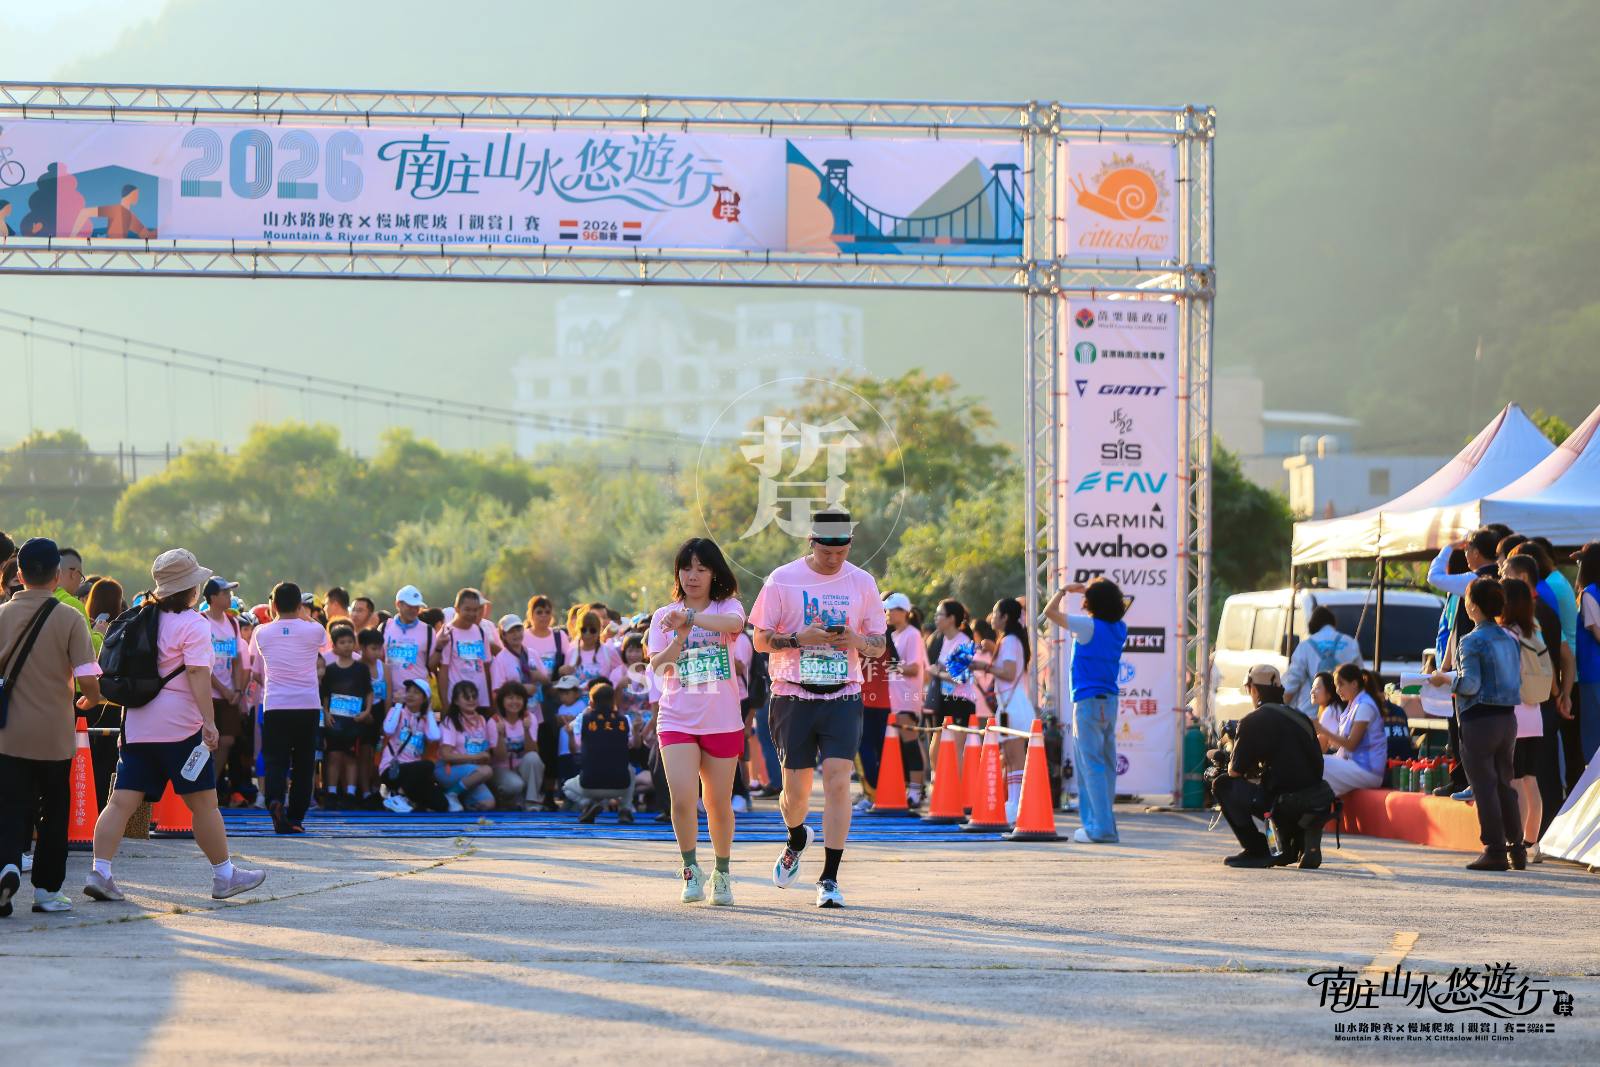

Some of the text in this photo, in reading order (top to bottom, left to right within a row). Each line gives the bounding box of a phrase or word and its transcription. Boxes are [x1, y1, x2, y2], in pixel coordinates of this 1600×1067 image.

[180, 128, 364, 202] 2026
[377, 132, 723, 212] 南庄山水悠遊行
[583, 220, 618, 230] 2026
[263, 230, 320, 241] Mountain
[324, 232, 333, 241] &
[338, 232, 369, 242] River
[375, 232, 398, 242] Run
[417, 233, 475, 243] Cittaslow
[479, 234, 500, 243] Hill
[505, 234, 540, 244] Climb
[1098, 384, 1167, 396] GIANT
[1073, 512, 1164, 529] GARMIN
[1074, 534, 1168, 559] wahoo
[1111, 569, 1167, 586] SWISS
[1122, 635, 1163, 647] TEKT
[803, 661, 847, 674] 30480
